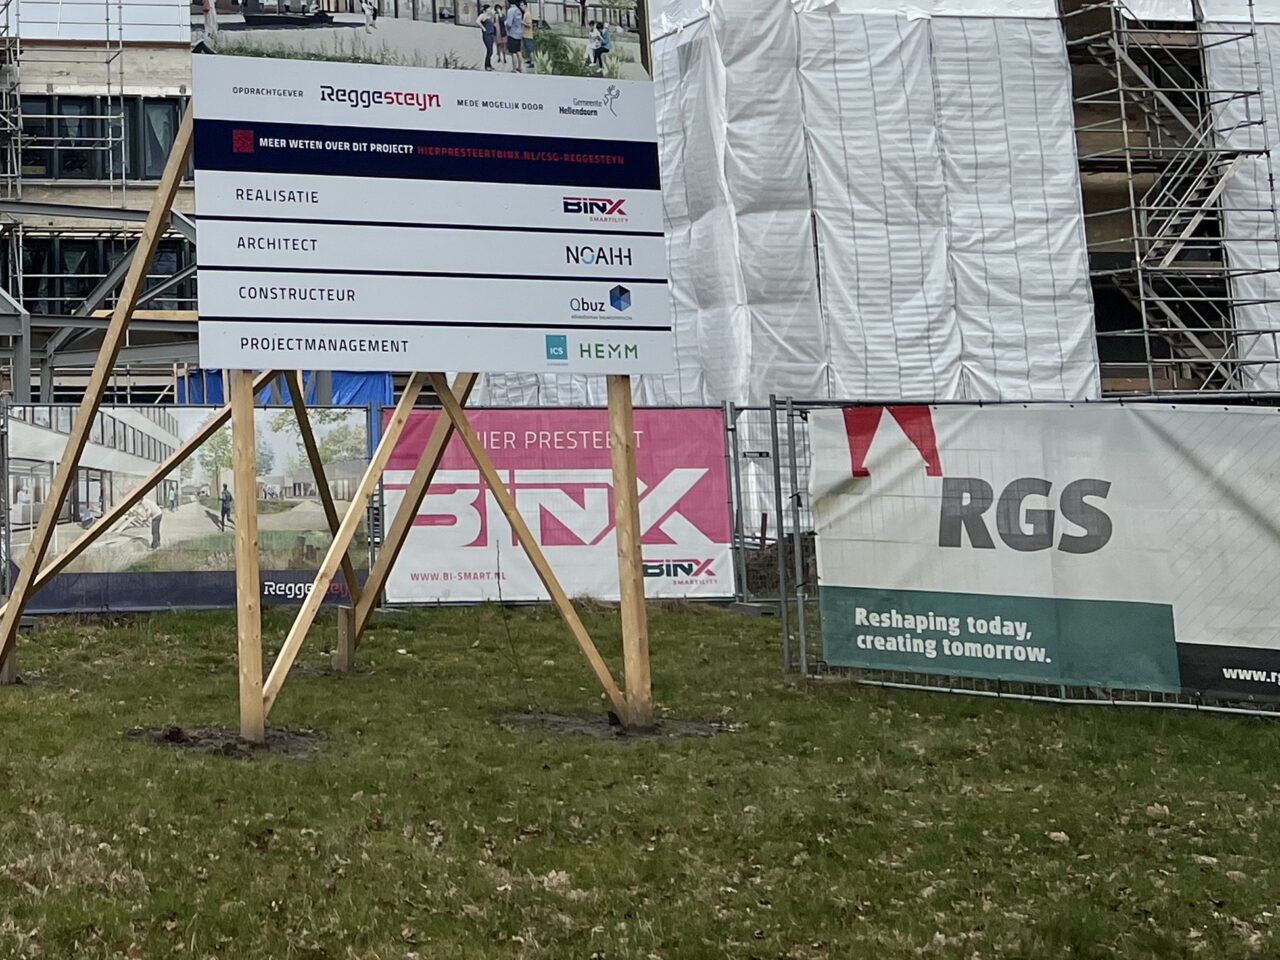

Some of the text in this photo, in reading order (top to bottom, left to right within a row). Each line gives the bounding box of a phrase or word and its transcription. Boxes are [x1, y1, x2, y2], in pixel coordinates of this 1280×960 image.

[232, 86, 304, 98] OPDRACHTGEVER
[320, 85, 441, 112] Reggesteyn
[457, 99, 544, 111] MEDE MOGELIJK DOOR
[573, 97, 603, 108] Gemeente
[259, 137, 414, 154] MEER WETEN OVER DIT PROJECT?
[236, 188, 319, 203] REALISATIE
[563, 197, 627, 215] BINX
[237, 237, 318, 251] ARCHITECT
[239, 286, 356, 301] CONSTRUCTEUR
[570, 297, 605, 312] Qbuz
[240, 337, 409, 353] PROJECTMANAGEMENT
[549, 347, 564, 355] ICS
[580, 343, 638, 359] HEMM
[525, 431, 644, 449] PRESTEET
[939, 477, 1113, 554] RGS
[410, 571, 507, 581] WWW.BI-SMART.NL
[642, 558, 716, 578] BINX
[855, 607, 1032, 641] Reshaping today,
[856, 634, 1052, 663] creating tomorrow.
